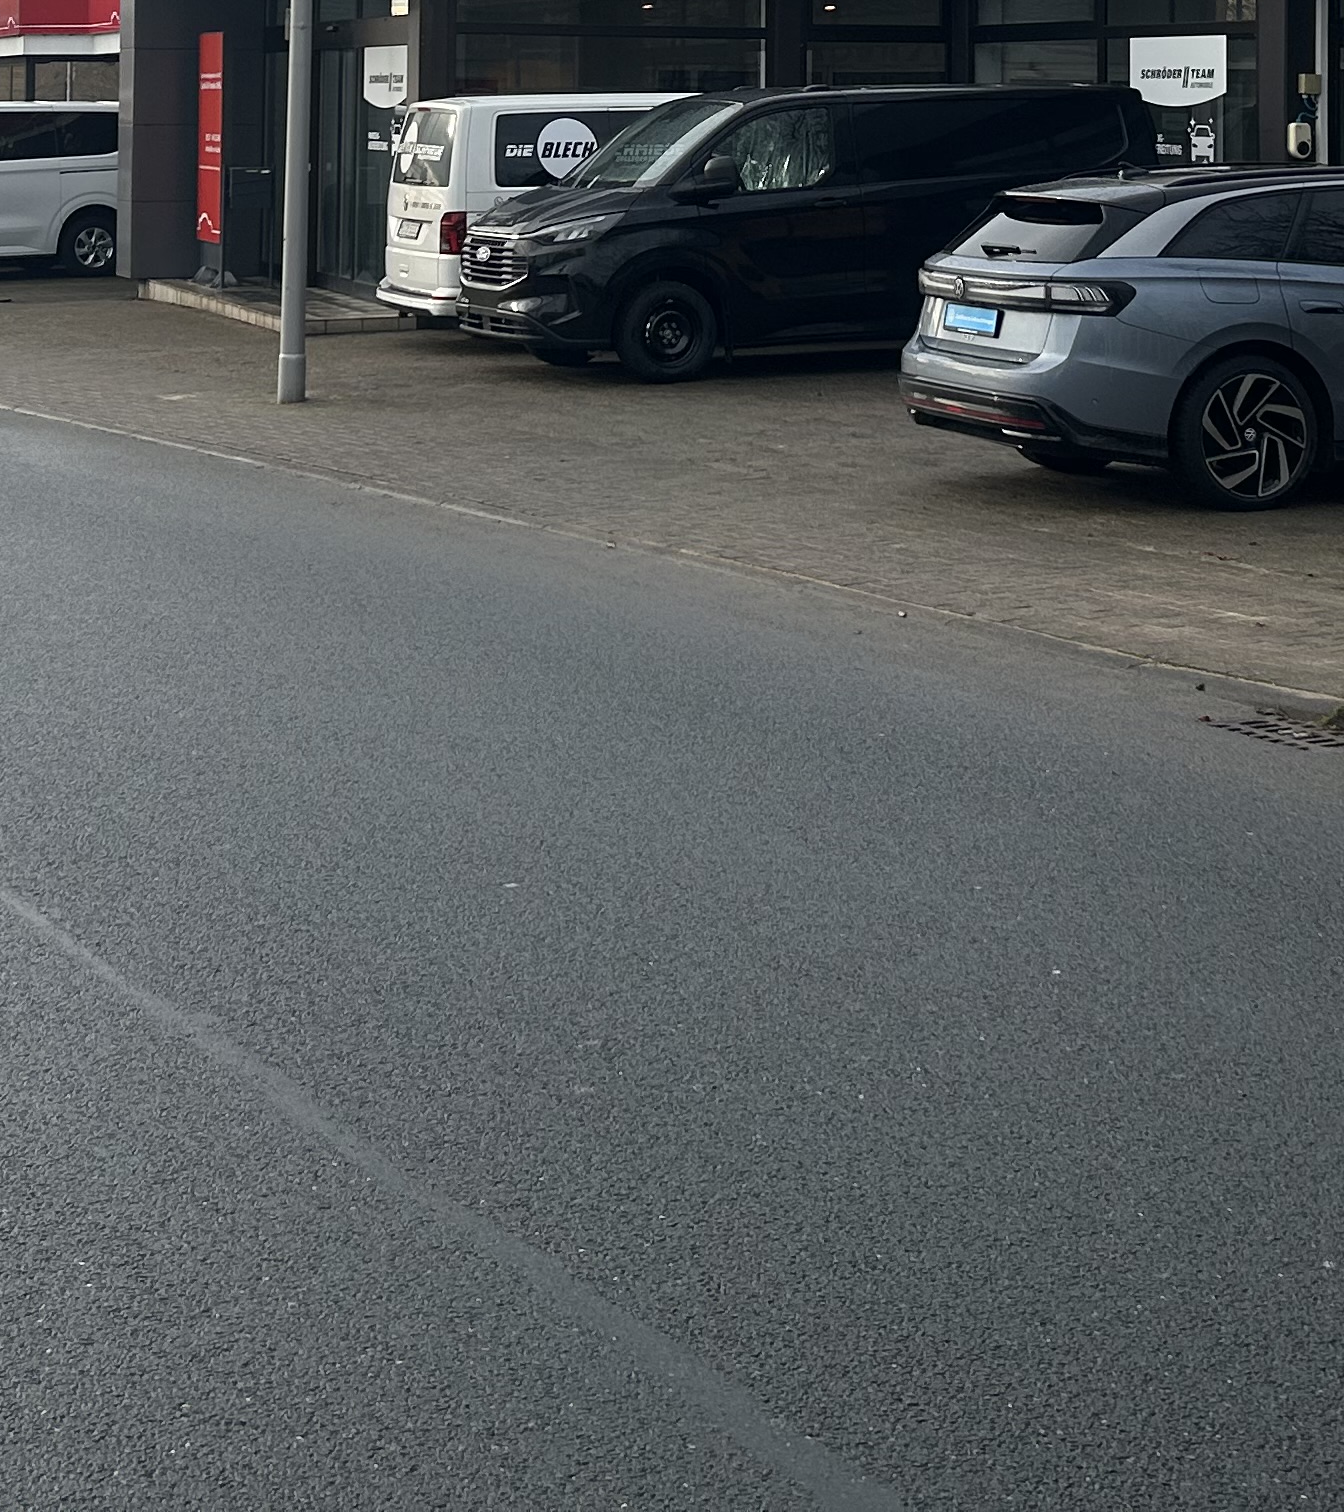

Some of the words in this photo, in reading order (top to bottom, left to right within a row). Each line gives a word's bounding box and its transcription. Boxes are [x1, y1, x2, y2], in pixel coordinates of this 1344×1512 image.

[1140, 65, 1183, 80] SCHRÖDER
[1190, 68, 1215, 79] TEAM
[505, 143, 534, 158] DIE
[541, 141, 595, 159] BLECH
